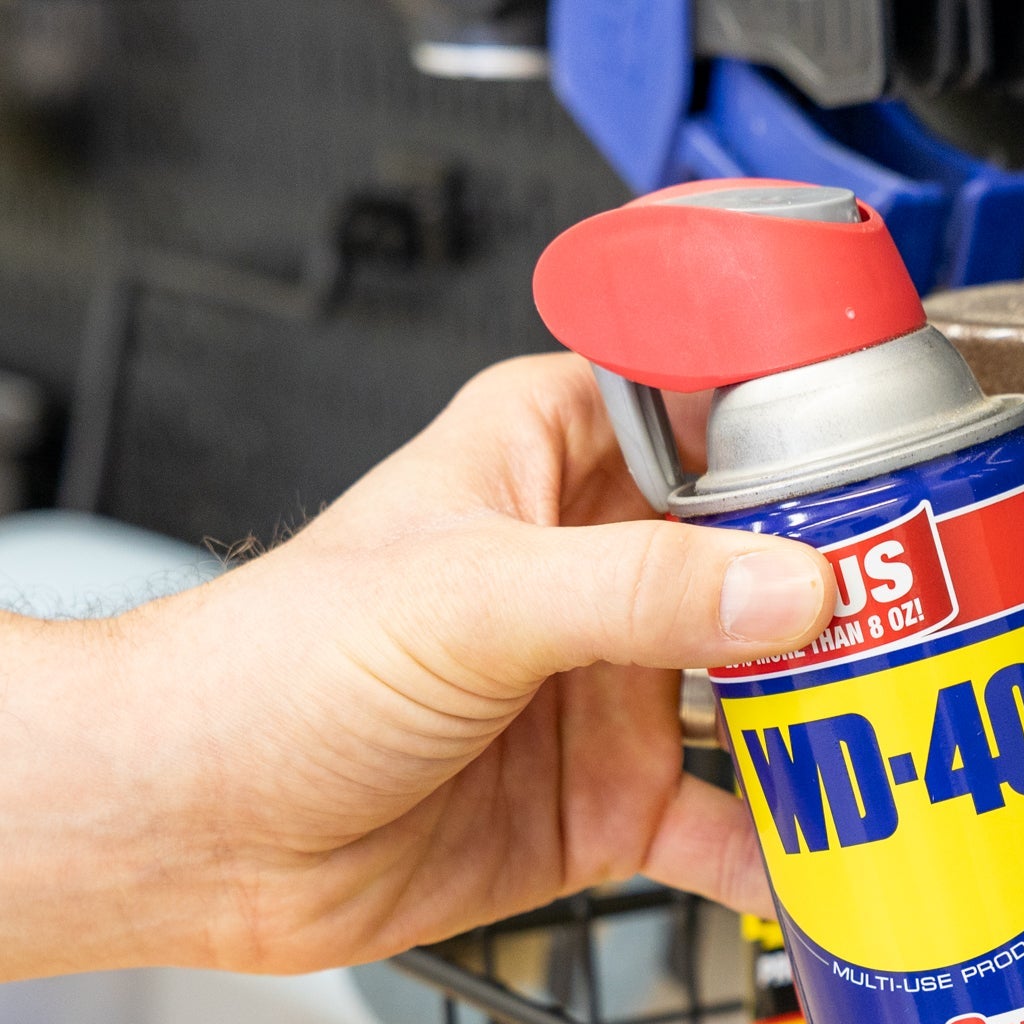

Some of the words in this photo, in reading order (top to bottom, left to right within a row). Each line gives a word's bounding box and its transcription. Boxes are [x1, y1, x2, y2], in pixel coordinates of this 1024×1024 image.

[831, 540, 914, 618] US
[868, 614, 885, 639] 8
[888, 597, 925, 632] OZ!
[833, 961, 954, 993] MULTI-USE
